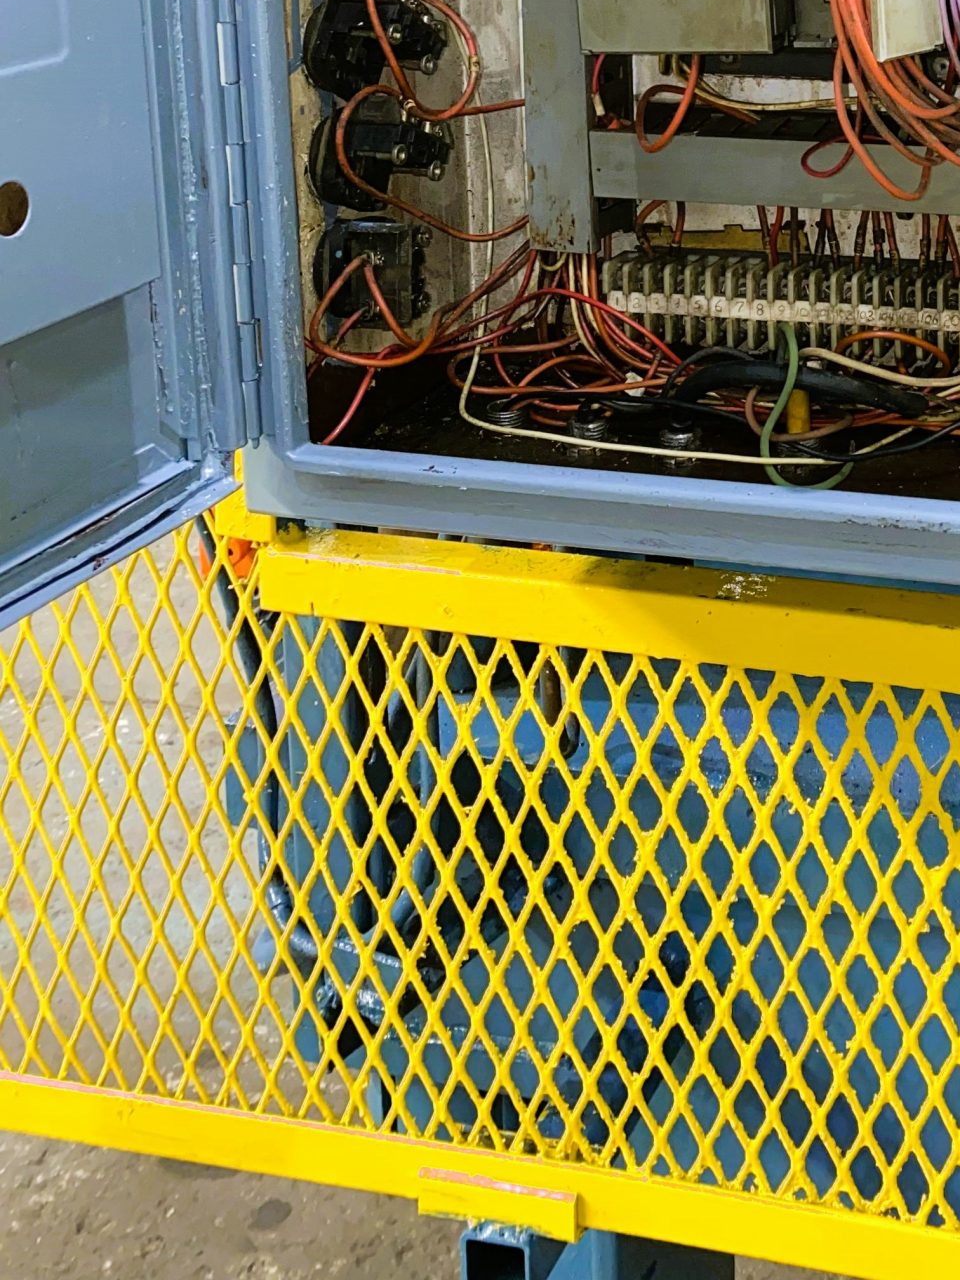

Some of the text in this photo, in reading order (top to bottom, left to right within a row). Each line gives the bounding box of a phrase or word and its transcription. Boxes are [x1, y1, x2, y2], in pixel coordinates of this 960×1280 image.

[714, 299, 723, 313] 6
[735, 300, 744, 313] 7
[756, 302, 764, 316] 8
[778, 304, 785, 317] 9
